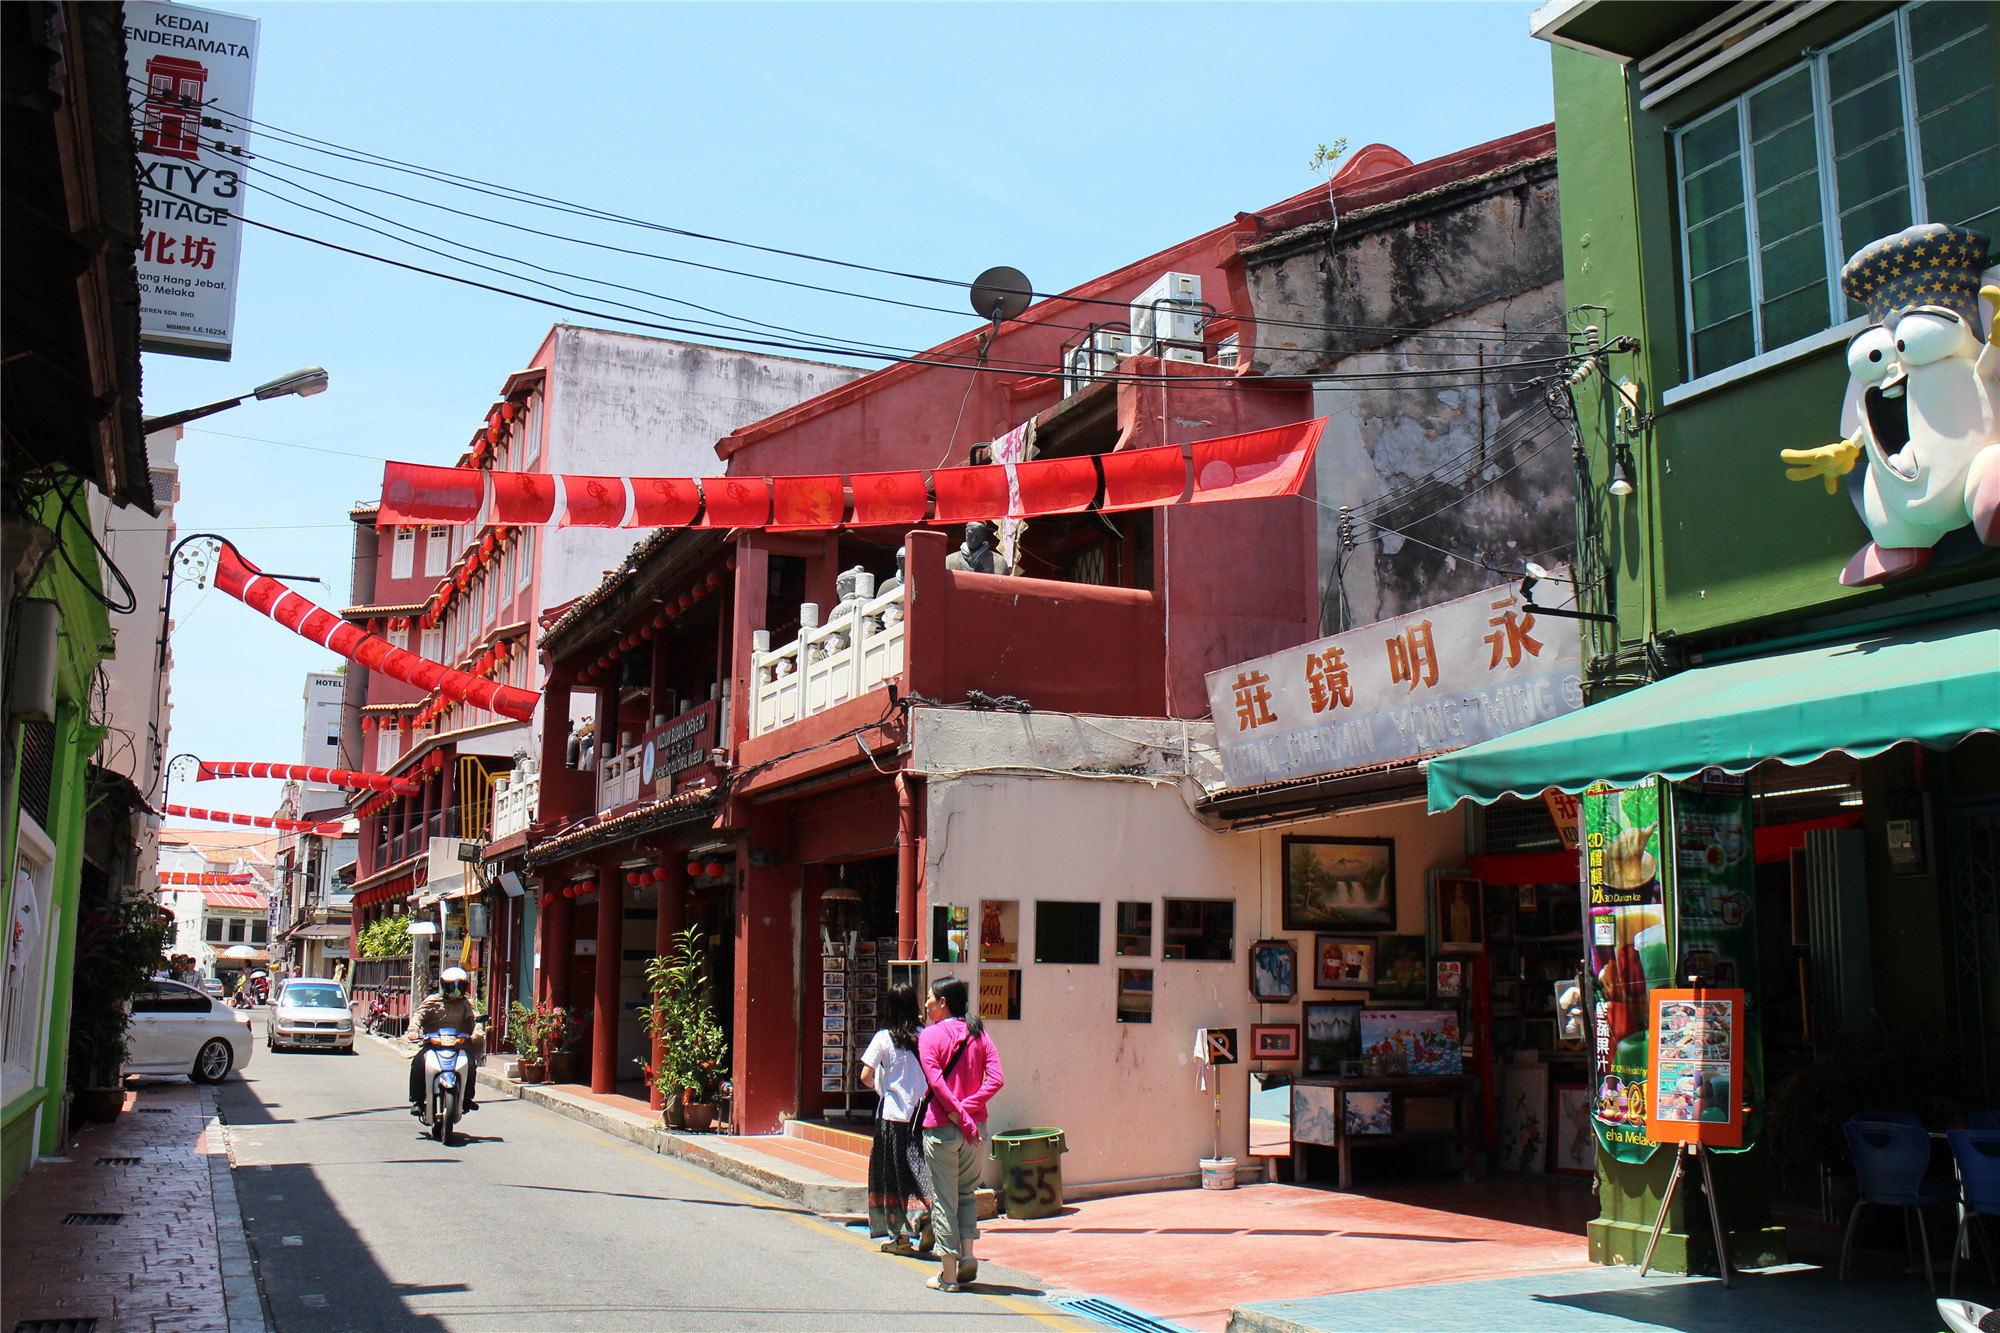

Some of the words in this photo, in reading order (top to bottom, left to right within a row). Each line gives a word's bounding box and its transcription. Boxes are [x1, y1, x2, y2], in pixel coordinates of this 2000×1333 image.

[155, 13, 208, 34] KEDAI
[137, 273, 160, 283] ong
[163, 275, 191, 287] Hang
[195, 278, 227, 291] Jebat,
[154, 285, 195, 298] Melaka
[1389, 700, 1465, 746] YONG
[1480, 678, 1557, 730] MING
[1614, 893, 1632, 902] Durian
[1633, 893, 1641, 901] Ice
[269, 896, 279, 927] HOTEL
[1606, 1129, 1623, 1141] eha
[1009, 1166, 1058, 1205] 55
